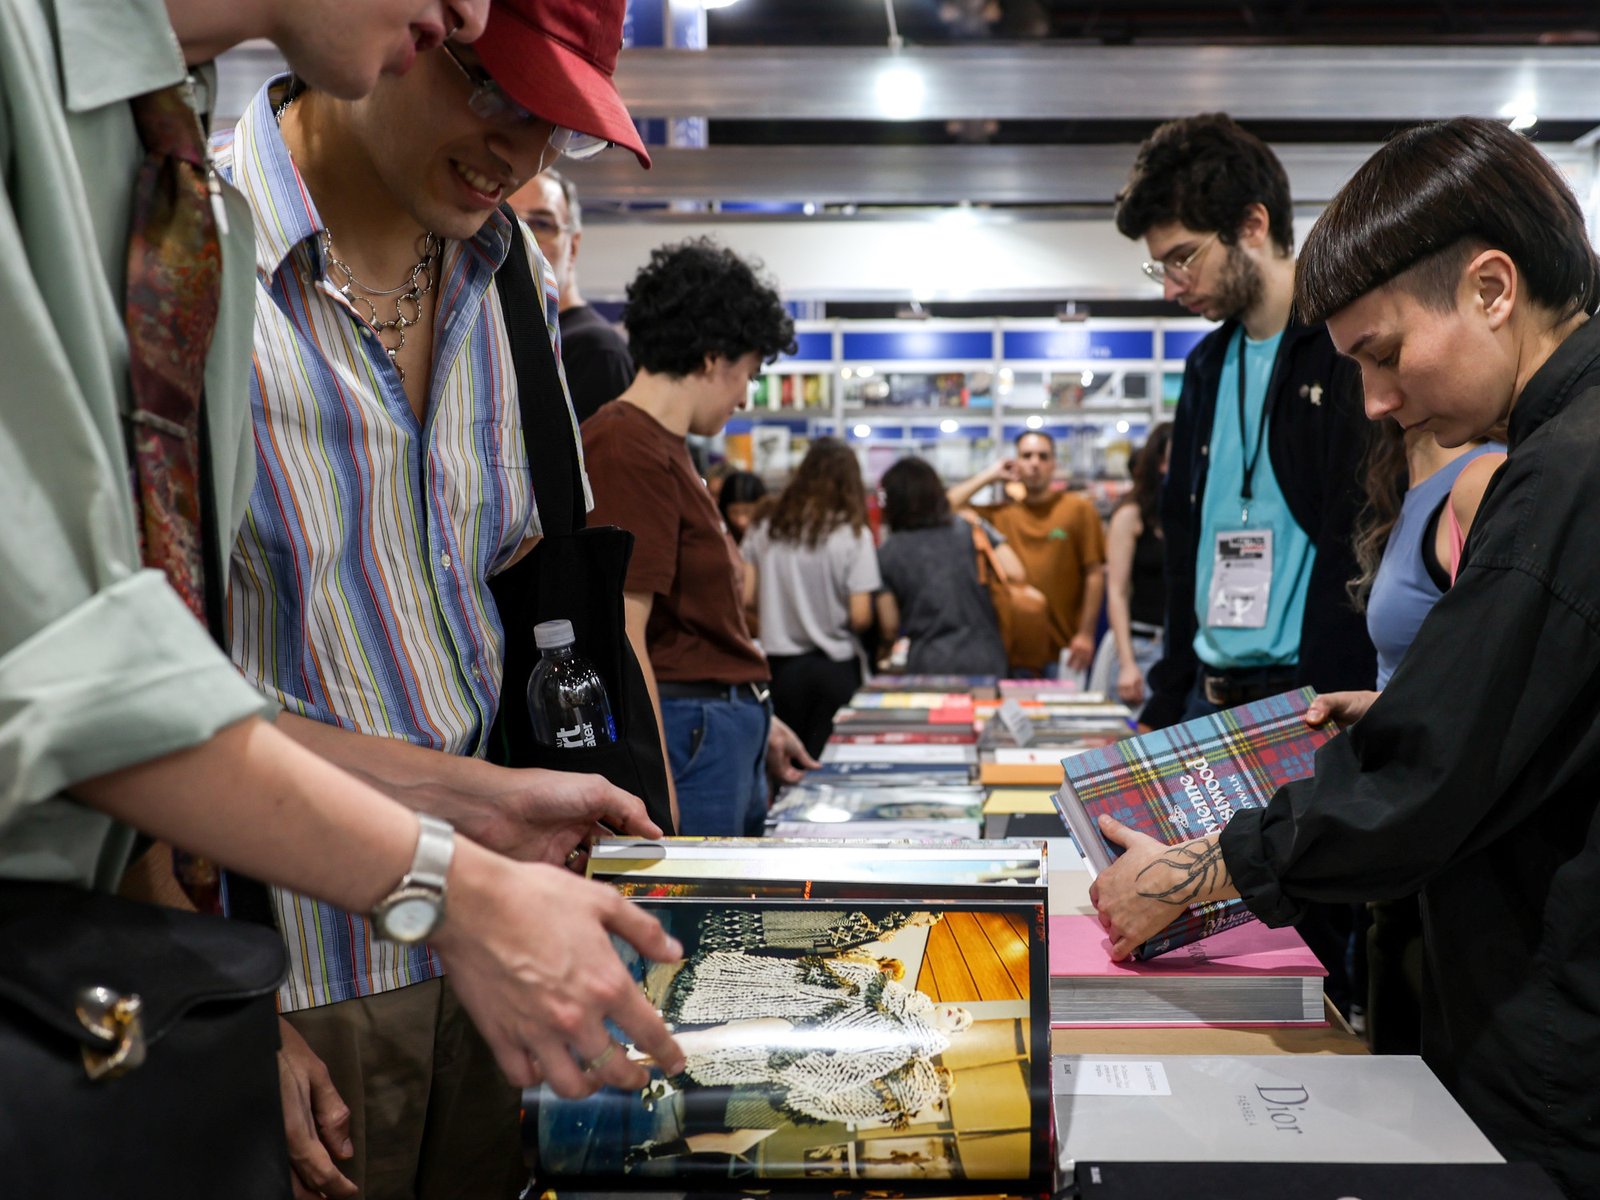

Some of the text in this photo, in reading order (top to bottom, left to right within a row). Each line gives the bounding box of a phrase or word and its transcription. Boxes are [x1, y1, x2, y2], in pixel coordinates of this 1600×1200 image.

[1180, 774, 1222, 835] vienne
[1186, 756, 1235, 824] stwood
[1228, 774, 1252, 809] TWALK
[1254, 1083, 1309, 1134] Dior
